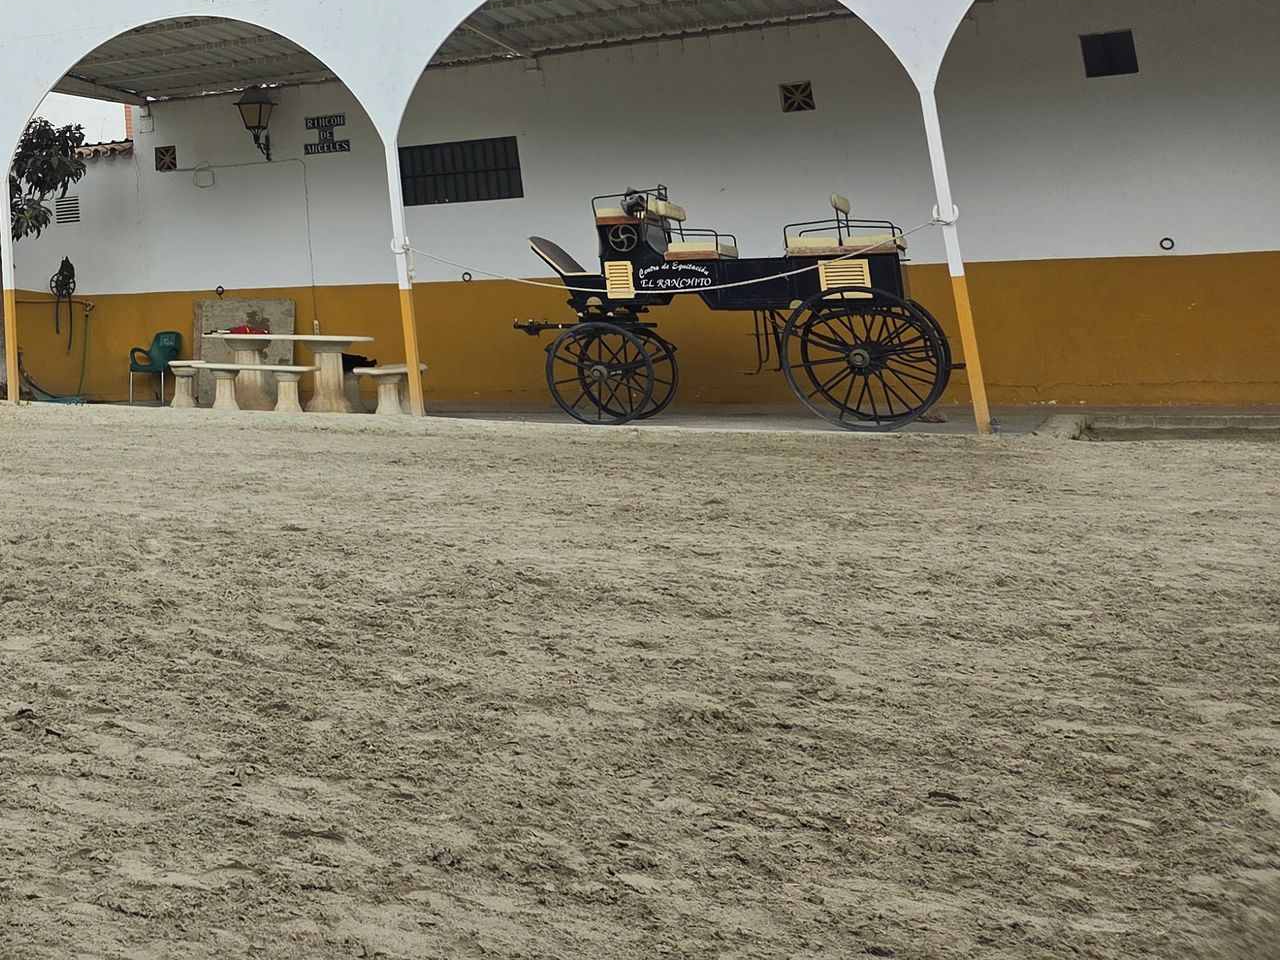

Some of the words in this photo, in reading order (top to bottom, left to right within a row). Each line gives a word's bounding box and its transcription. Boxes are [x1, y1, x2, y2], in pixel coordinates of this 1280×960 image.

[307, 116, 344, 128] RINCON
[320, 130, 332, 140] DE
[307, 142, 348, 153] ANGELES
[639, 266, 660, 279] Centro
[640, 279, 655, 288] EL
[657, 277, 711, 288] RANCHITO
